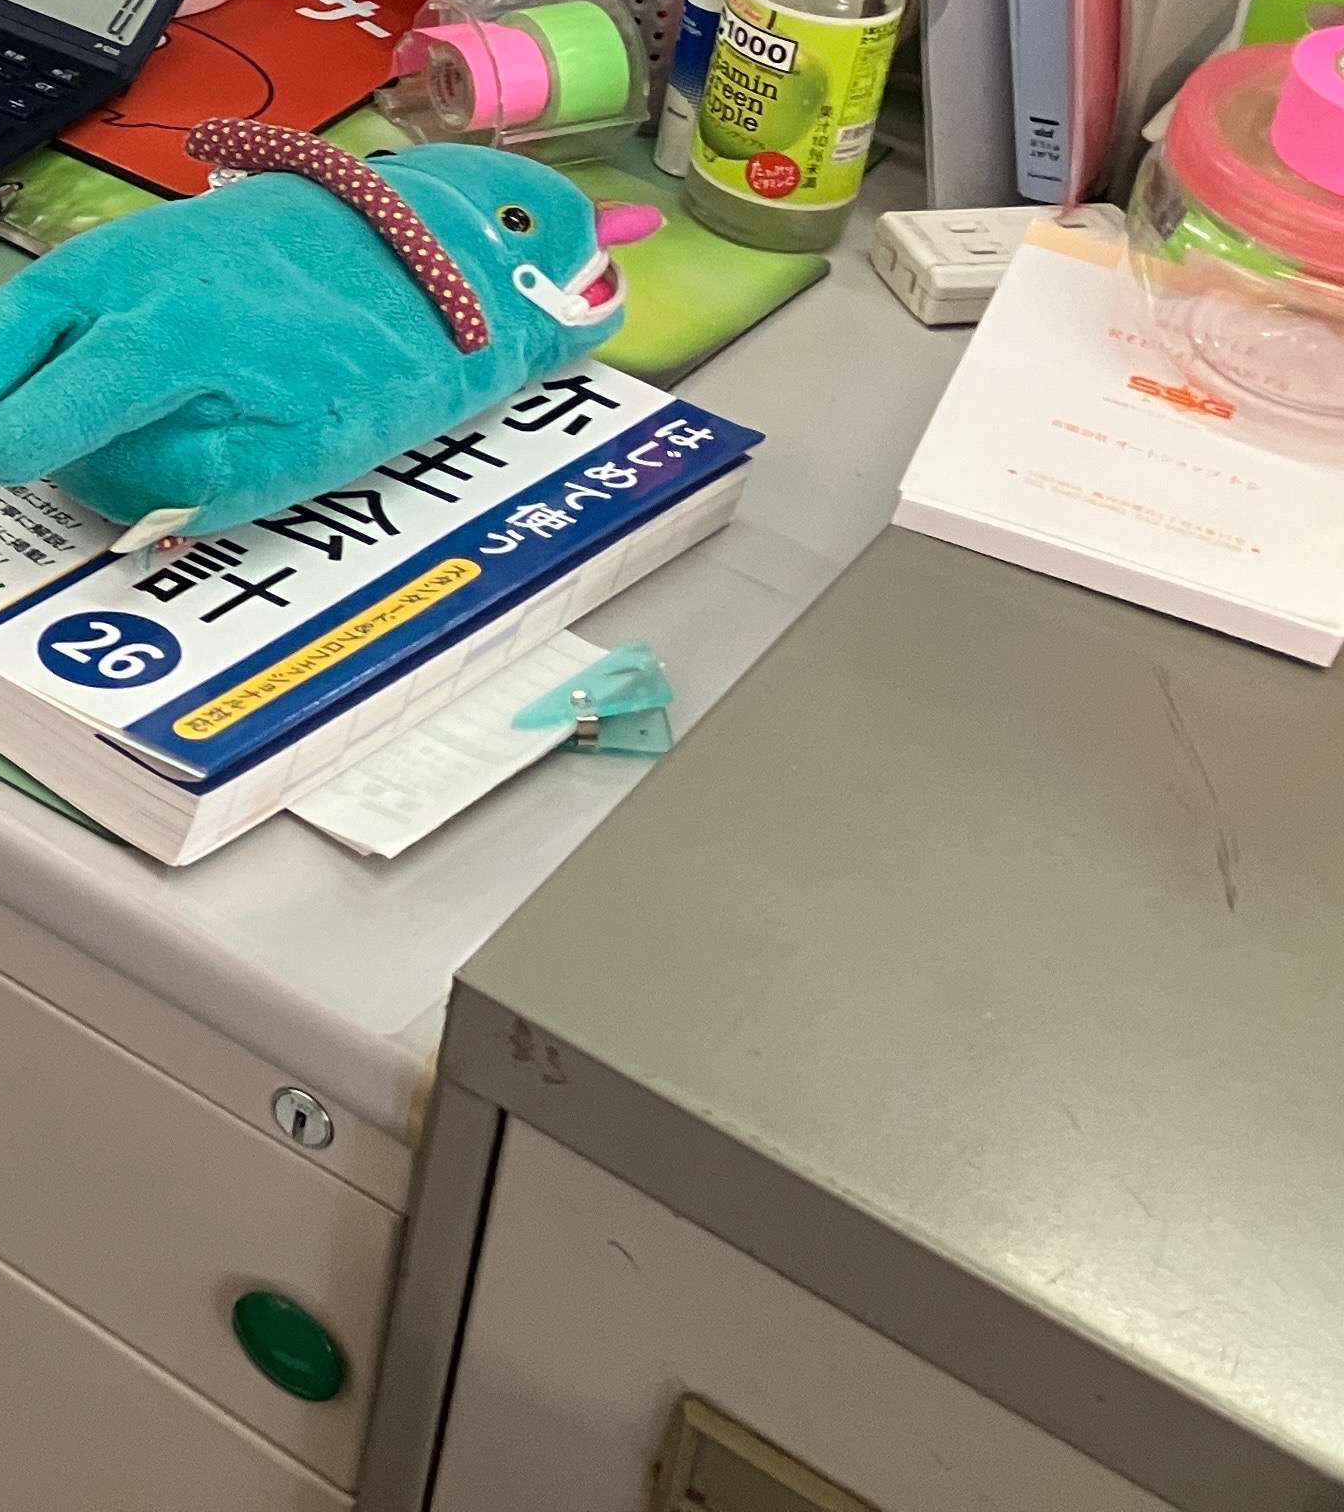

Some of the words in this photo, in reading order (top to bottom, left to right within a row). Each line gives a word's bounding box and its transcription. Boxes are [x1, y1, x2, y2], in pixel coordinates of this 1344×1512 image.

[708, 93, 759, 132] pple
[711, 74, 763, 115] reen
[479, 419, 714, 554] はじめて使う
[50, 621, 165, 681] 26
